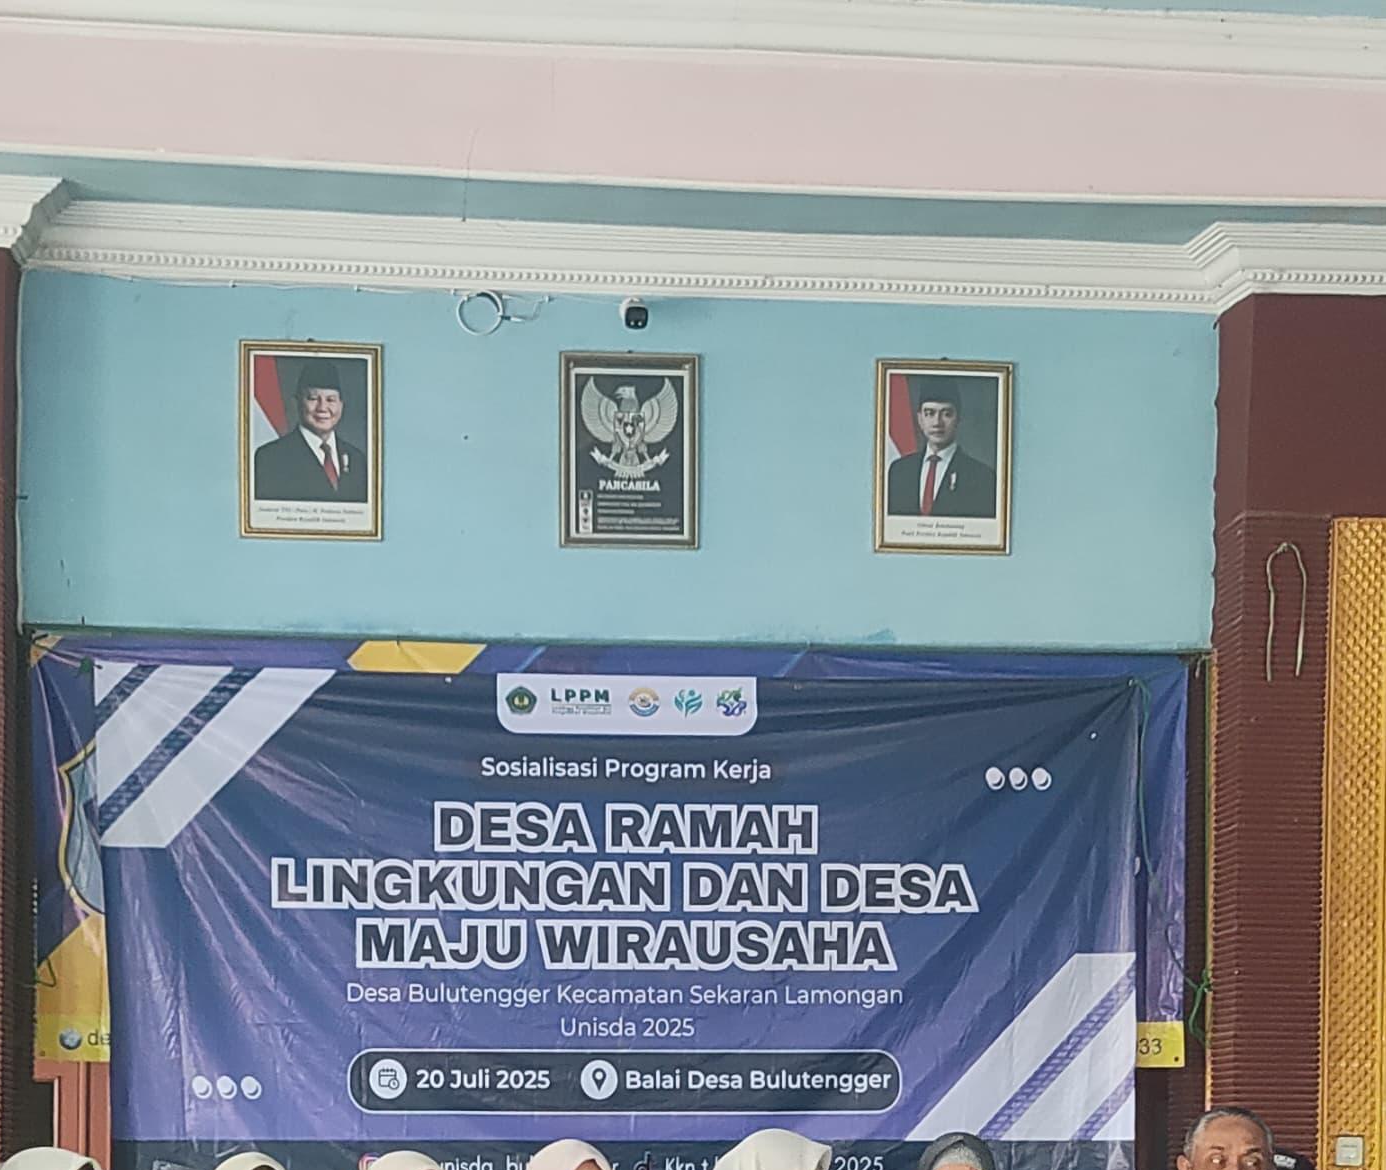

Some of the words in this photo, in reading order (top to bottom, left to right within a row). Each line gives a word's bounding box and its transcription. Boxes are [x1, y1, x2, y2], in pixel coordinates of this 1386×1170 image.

[551, 688, 610, 703] LPPM
[481, 756, 599, 778] Sosialisasi
[604, 758, 707, 783] Program
[713, 759, 772, 785] Kerja
[434, 801, 594, 853] DESA
[605, 803, 818, 855] RAMAH
[271, 857, 670, 912] LINGKUNGAN
[682, 861, 812, 913] DAN
[819, 862, 979, 914] DESA
[355, 918, 529, 970] MAJU
[537, 919, 899, 972] WIRAUSAHA
[346, 982, 402, 1003] Desa
[409, 982, 551, 1008] Bulutengger
[557, 984, 684, 1005] Kecamatan
[689, 984, 779, 1006] Sekaran
[784, 985, 903, 1011] Lamongan
[560, 1016, 637, 1038] Unisda
[641, 1018, 695, 1038] 2025
[416, 1070, 445, 1090] 20
[449, 1069, 491, 1091] Juli
[495, 1070, 551, 1090] 2025
[625, 1069, 683, 1091] Balai
[687, 1069, 745, 1091] Desa
[749, 1069, 892, 1096] Bulutengger
